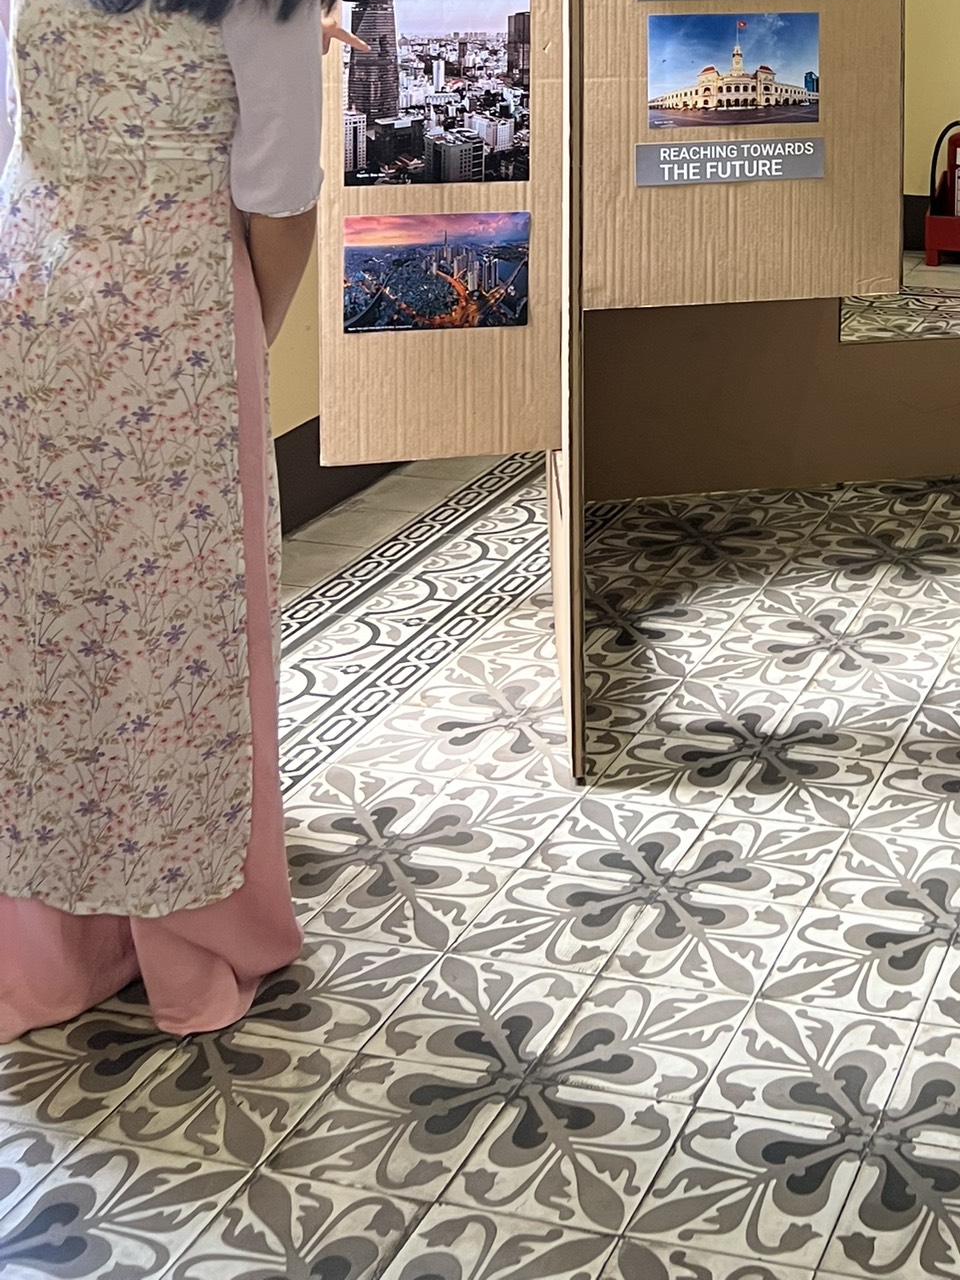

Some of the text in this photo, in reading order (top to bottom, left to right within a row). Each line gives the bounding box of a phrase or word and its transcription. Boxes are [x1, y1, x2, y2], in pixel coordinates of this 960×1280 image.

[660, 142, 814, 161] REACHING TOWARDS
[659, 159, 783, 181] THE FUTURE
